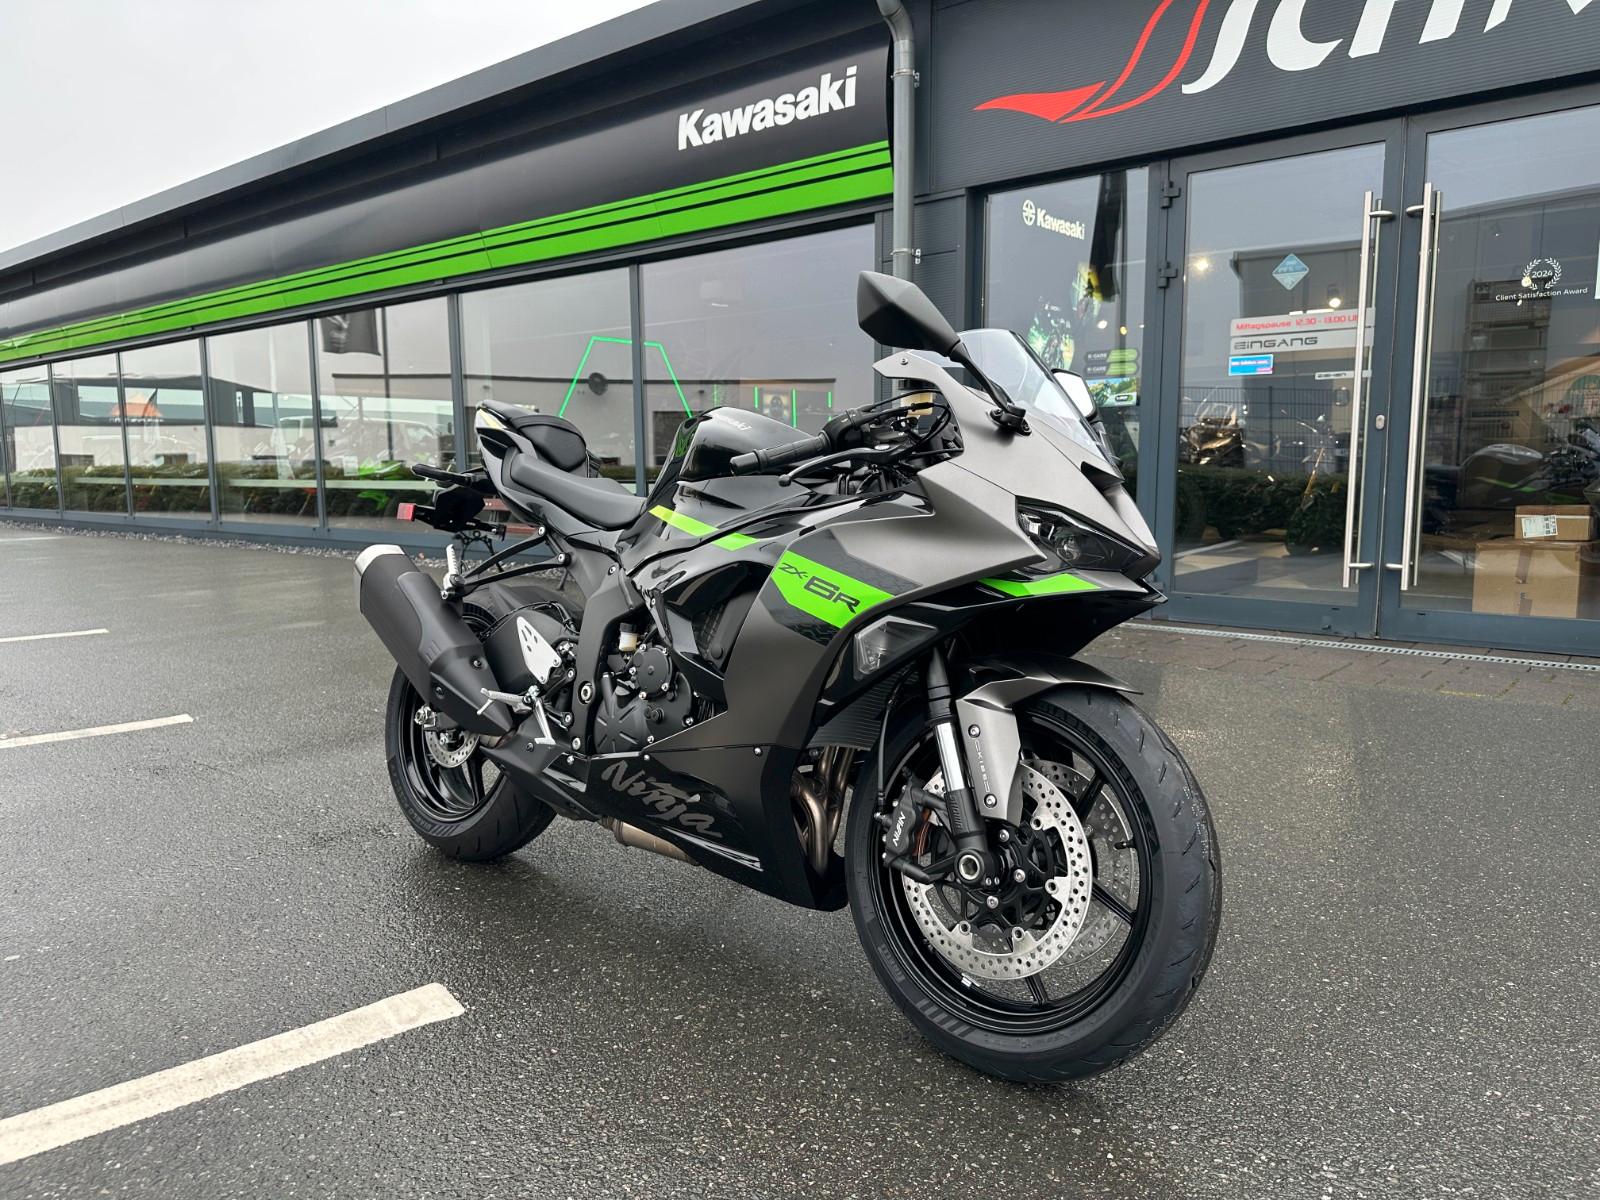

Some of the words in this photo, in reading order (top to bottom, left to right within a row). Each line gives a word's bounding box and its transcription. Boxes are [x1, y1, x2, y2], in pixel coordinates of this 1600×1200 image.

[678, 65, 858, 151] Kawasaki
[1036, 207, 1085, 240] Kawasaki
[1495, 293, 1516, 301] Client
[1518, 290, 1561, 299] Satisfaction
[1563, 287, 1588, 295] Award
[1531, 270, 1553, 279] 2024
[778, 562, 861, 614] ZX-6R
[601, 759, 724, 839] Ninja
